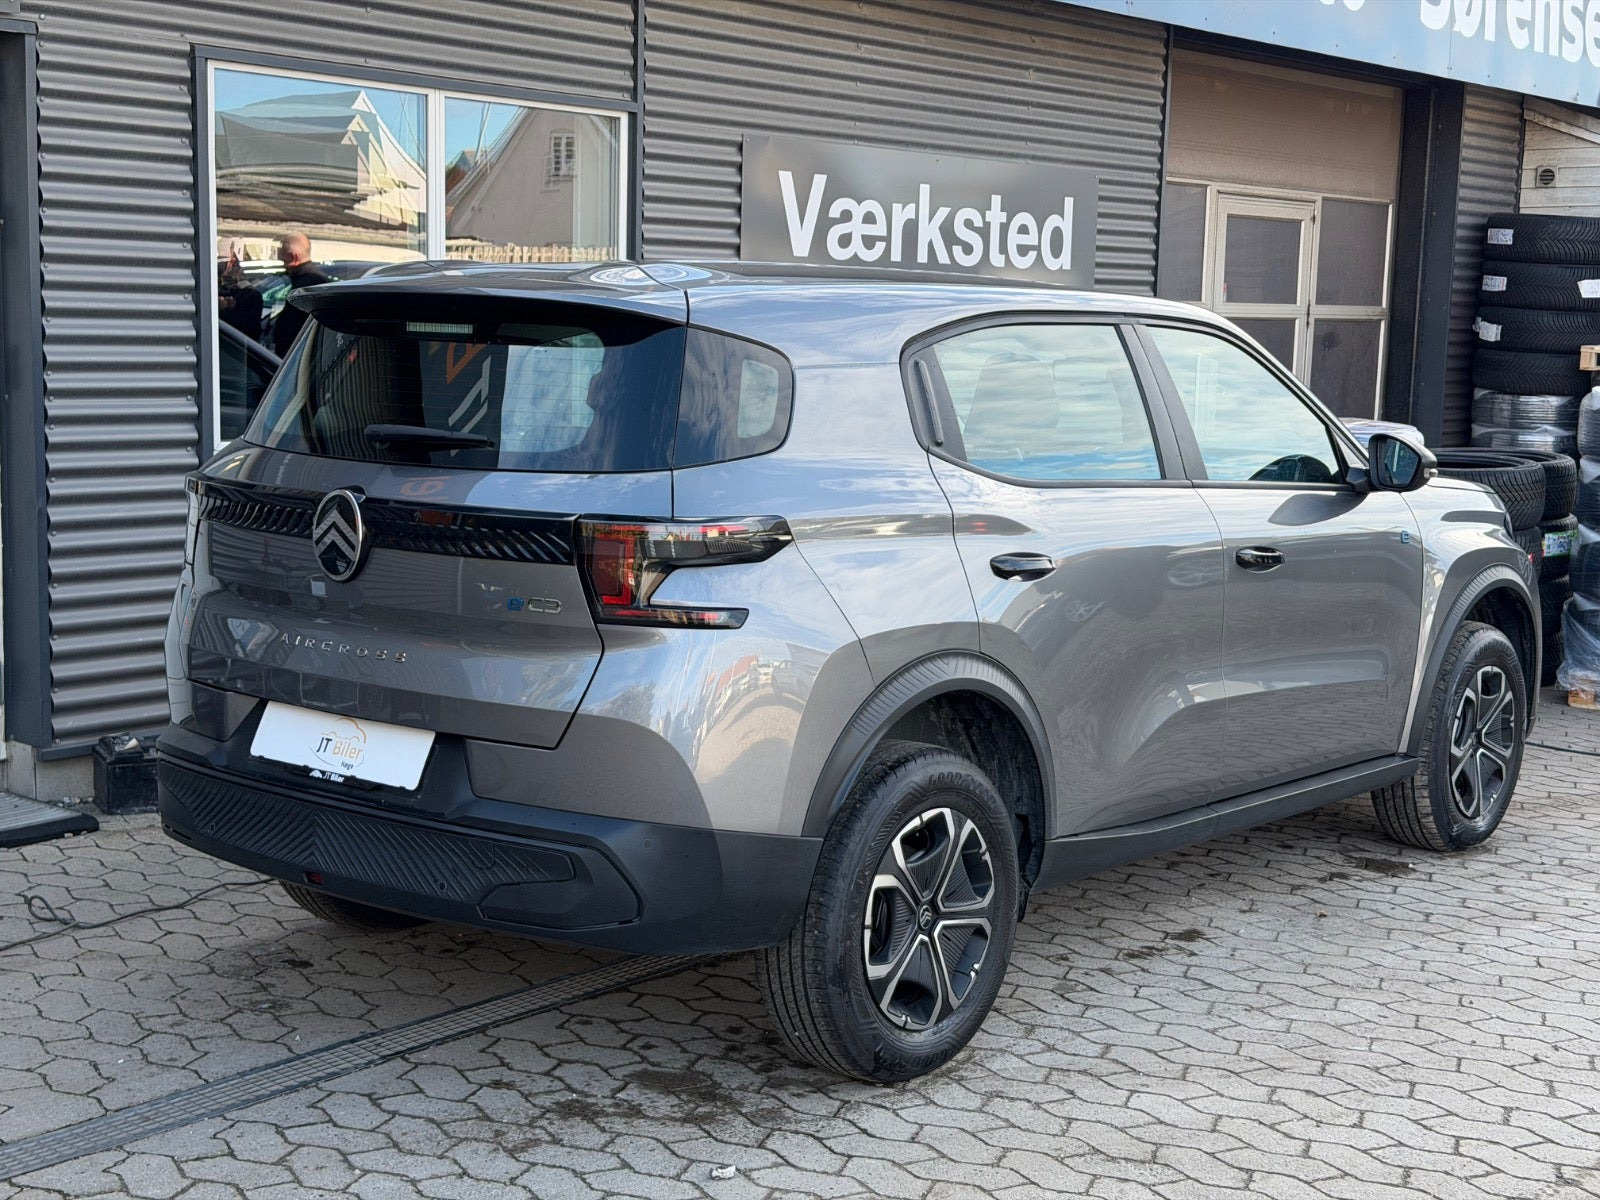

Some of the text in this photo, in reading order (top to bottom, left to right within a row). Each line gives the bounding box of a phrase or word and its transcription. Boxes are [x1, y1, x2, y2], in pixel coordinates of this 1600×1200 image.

[778, 170, 1074, 270] Værksted
[280, 633, 406, 663] AIRCROSS
[316, 737, 363, 760] JT Biler
